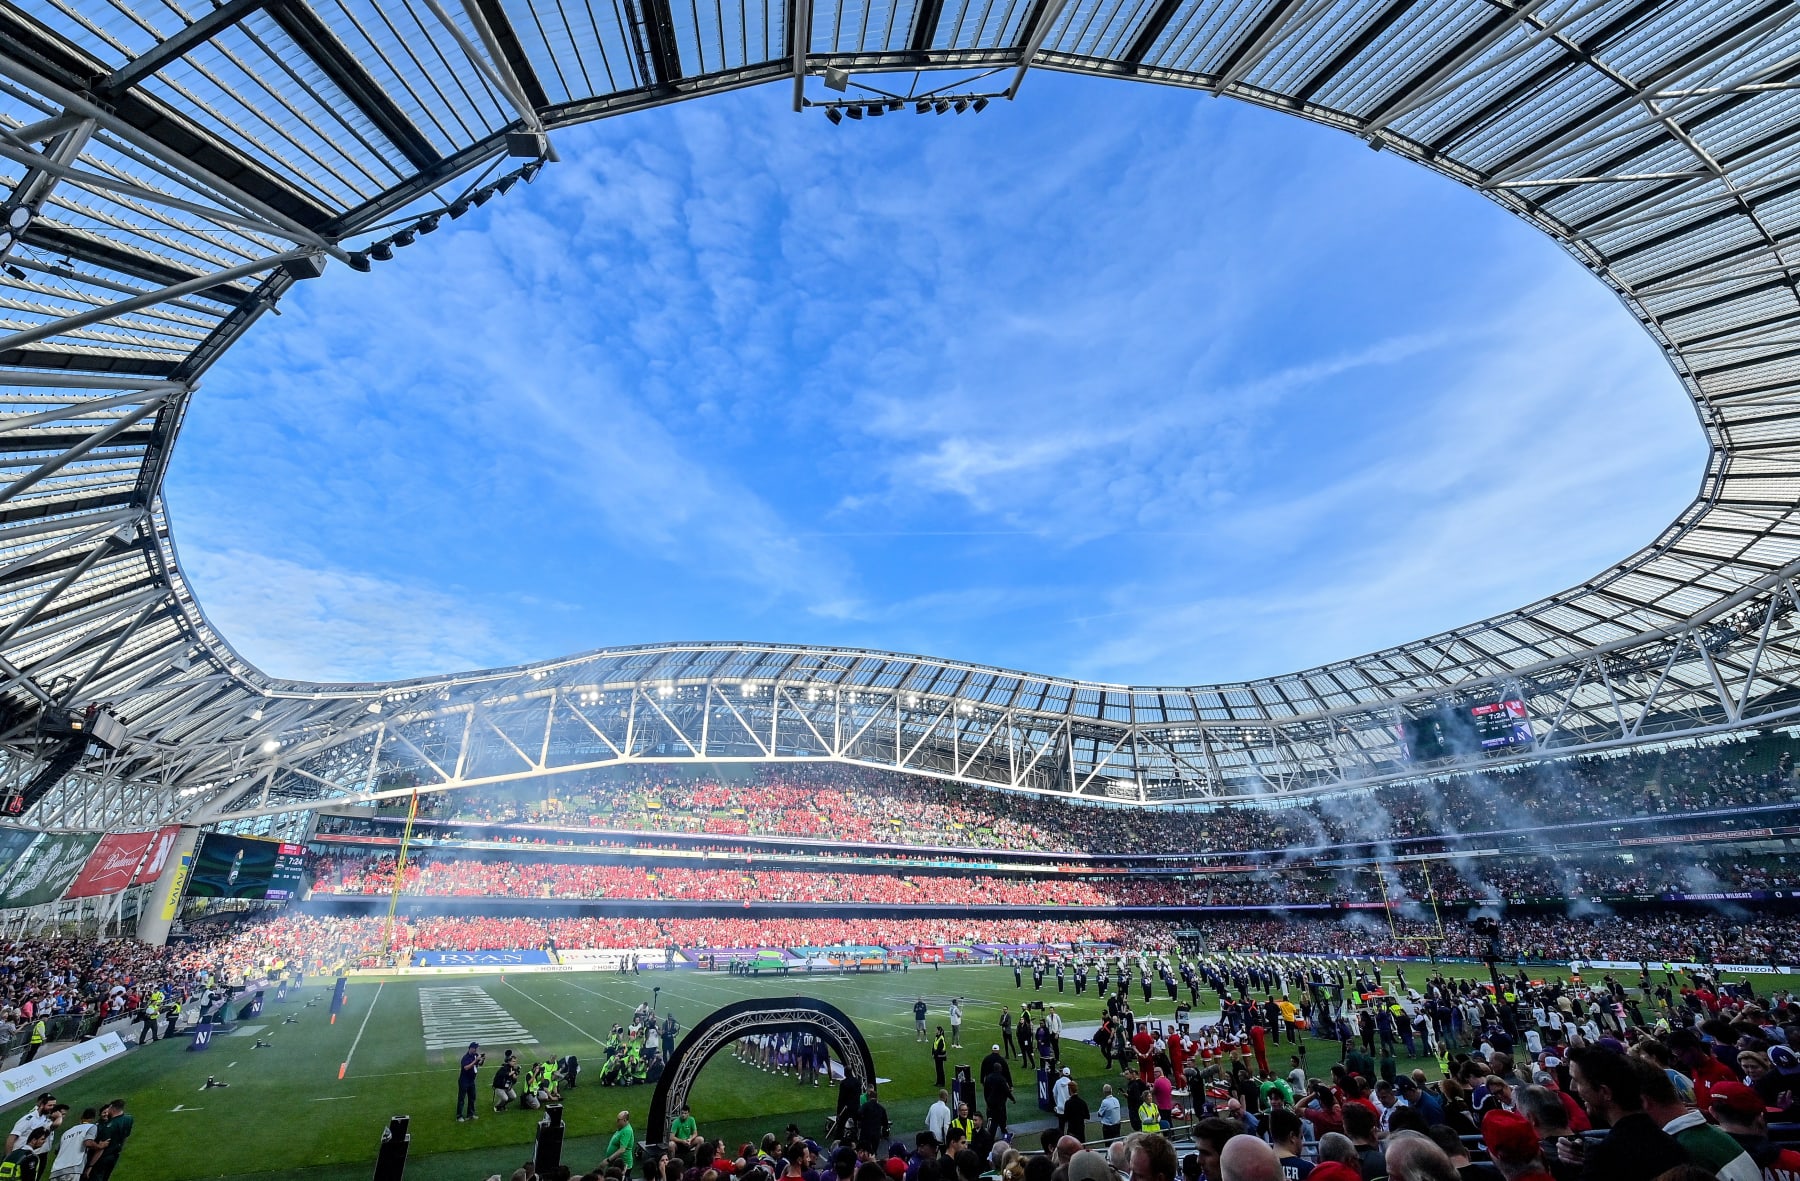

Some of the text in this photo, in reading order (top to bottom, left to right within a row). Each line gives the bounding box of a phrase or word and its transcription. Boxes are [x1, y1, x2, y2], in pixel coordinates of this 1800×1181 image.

[1488, 711, 1507, 720] 7:24
[288, 857, 303, 866] 7:24
[169, 872, 184, 906] AVIVA
[1683, 892, 1725, 900] NORTHWESTERN
[252, 1002, 261, 1012] N
[195, 1031, 208, 1044] N
[1039, 1081, 1047, 1100] N
